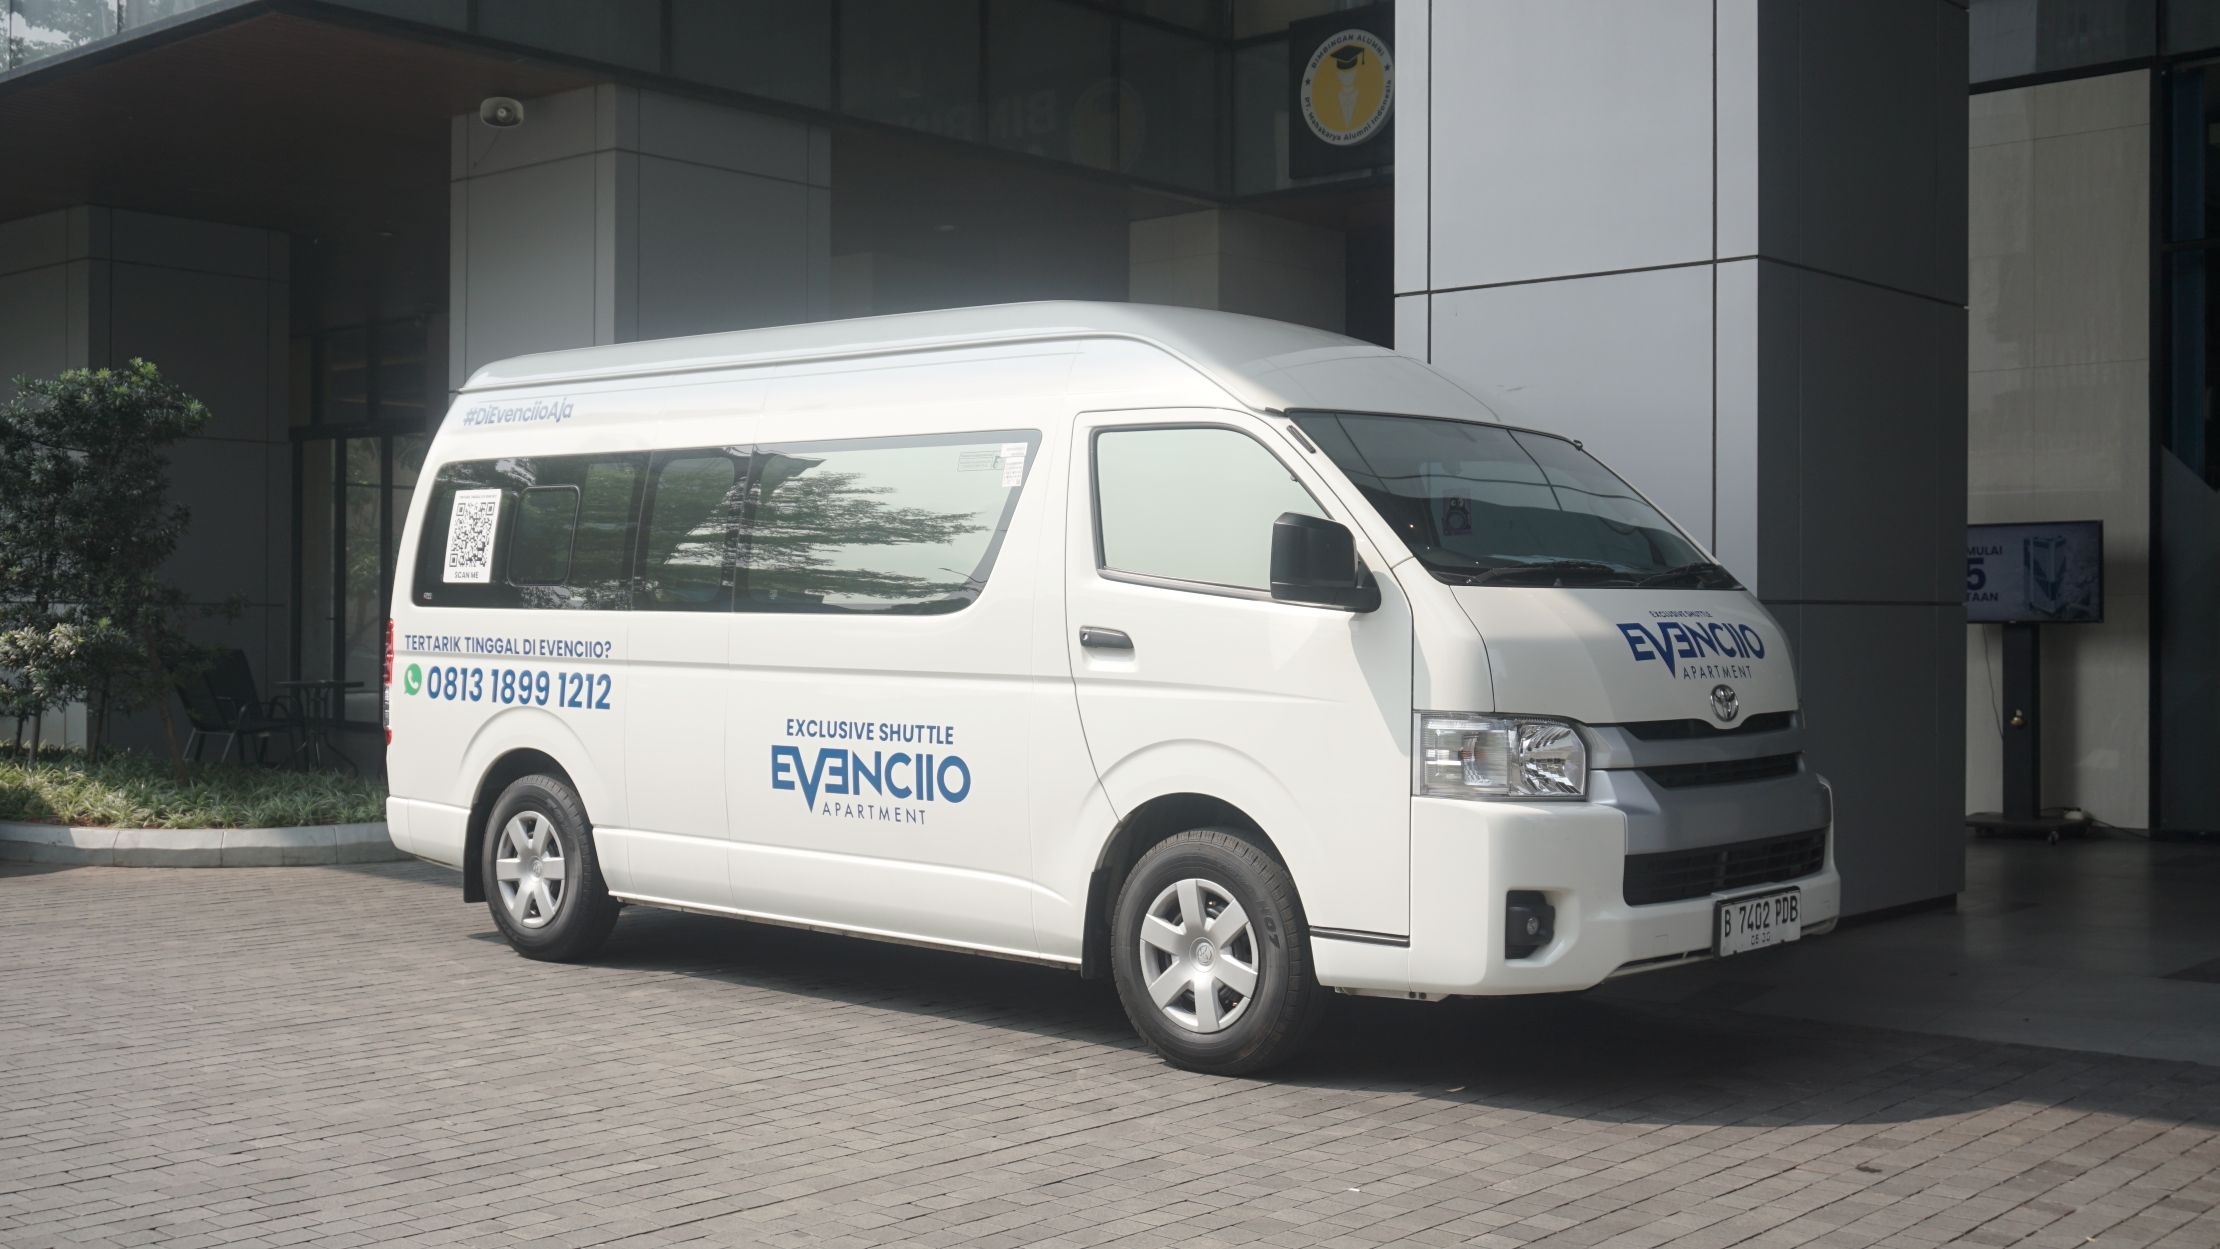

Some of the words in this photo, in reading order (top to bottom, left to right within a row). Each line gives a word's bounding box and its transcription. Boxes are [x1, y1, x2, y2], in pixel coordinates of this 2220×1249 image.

[1311, 33, 1354, 69] BIMBINGAN
[1357, 33, 1385, 57] ALUMNI
[1343, 124, 1372, 141] Alumni
[463, 398, 574, 426] #DiEvenciioAja
[454, 571, 470, 579] SCAN
[470, 571, 479, 579] ME
[404, 634, 462, 653] TERTARIK
[464, 636, 520, 655] TINGGAL
[523, 639, 536, 656] DI
[539, 639, 612, 659] EVENCIIO?
[1682, 665, 1753, 680] APARTMENT
[427, 665, 483, 702] 0813
[491, 668, 550, 706] 1899
[558, 671, 612, 710] 1212
[786, 718, 875, 741] EXCLUSIVE
[879, 722, 954, 745] SHUTTLE
[822, 801, 926, 825] APARTMENT
[1724, 909, 1732, 937] B
[1739, 901, 1770, 934] 7402
[1775, 895, 1798, 926] PDB
